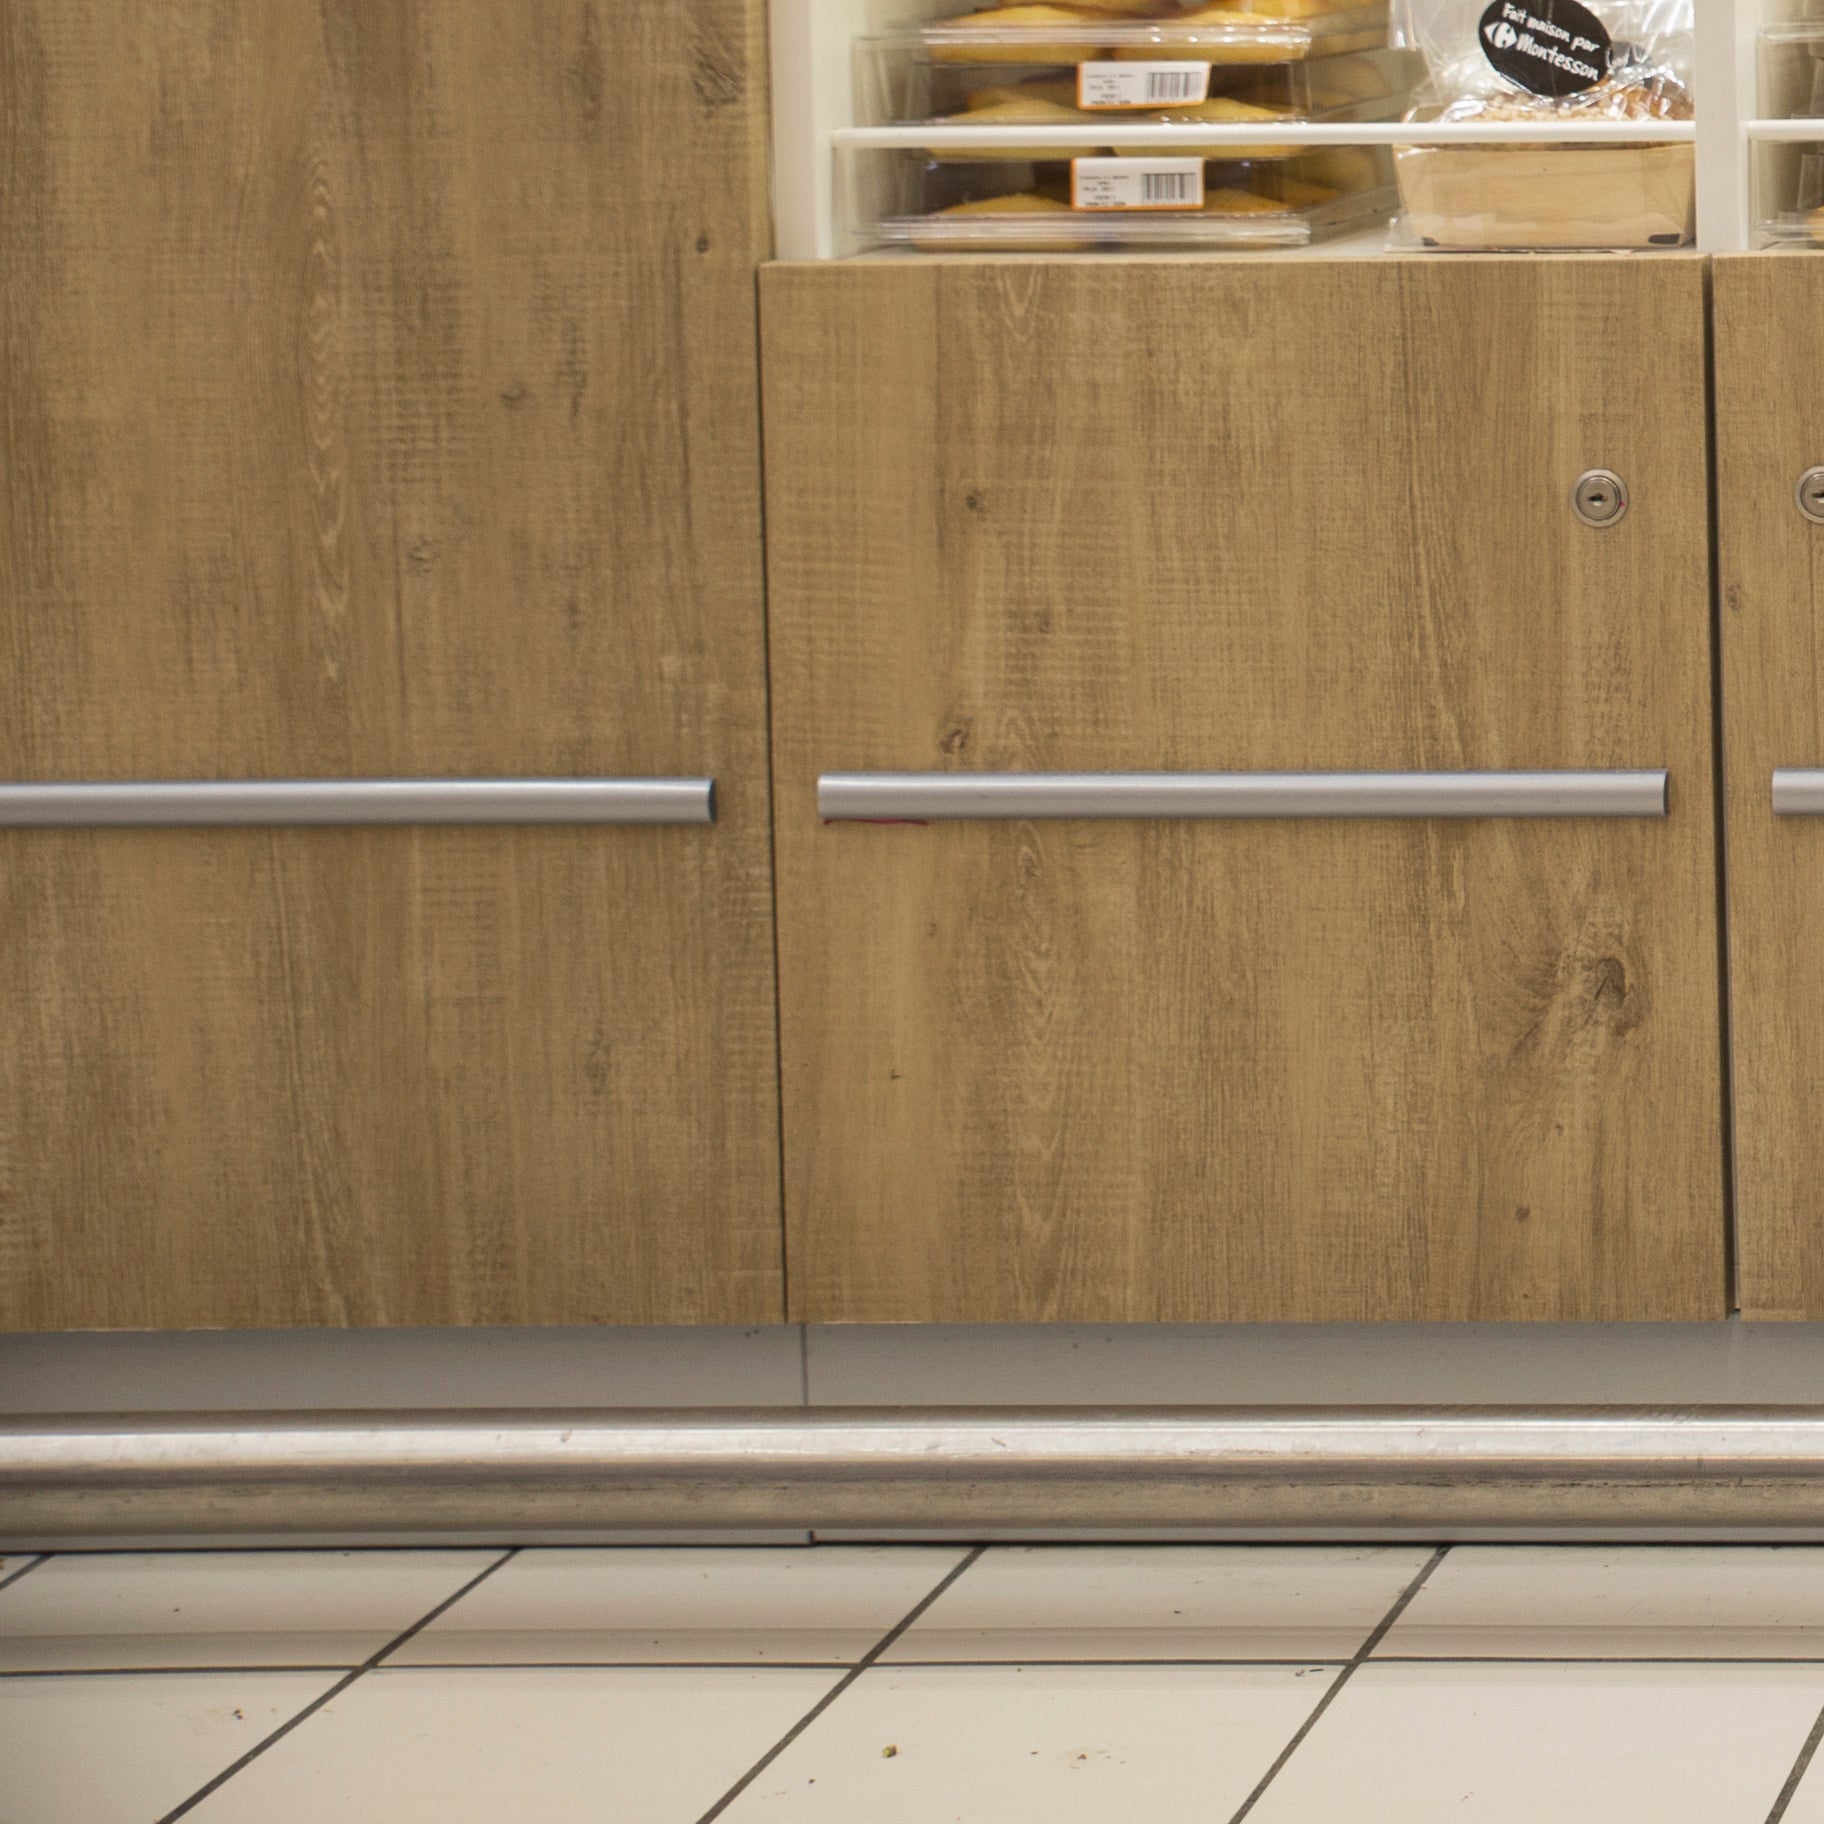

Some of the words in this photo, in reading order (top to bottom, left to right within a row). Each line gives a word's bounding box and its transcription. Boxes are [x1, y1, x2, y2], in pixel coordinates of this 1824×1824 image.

[1502, 1, 1527, 24] Fait
[1526, 16, 1571, 43] maison
[1570, 35, 1601, 52] par
[1515, 33, 1600, 82] Montesson
